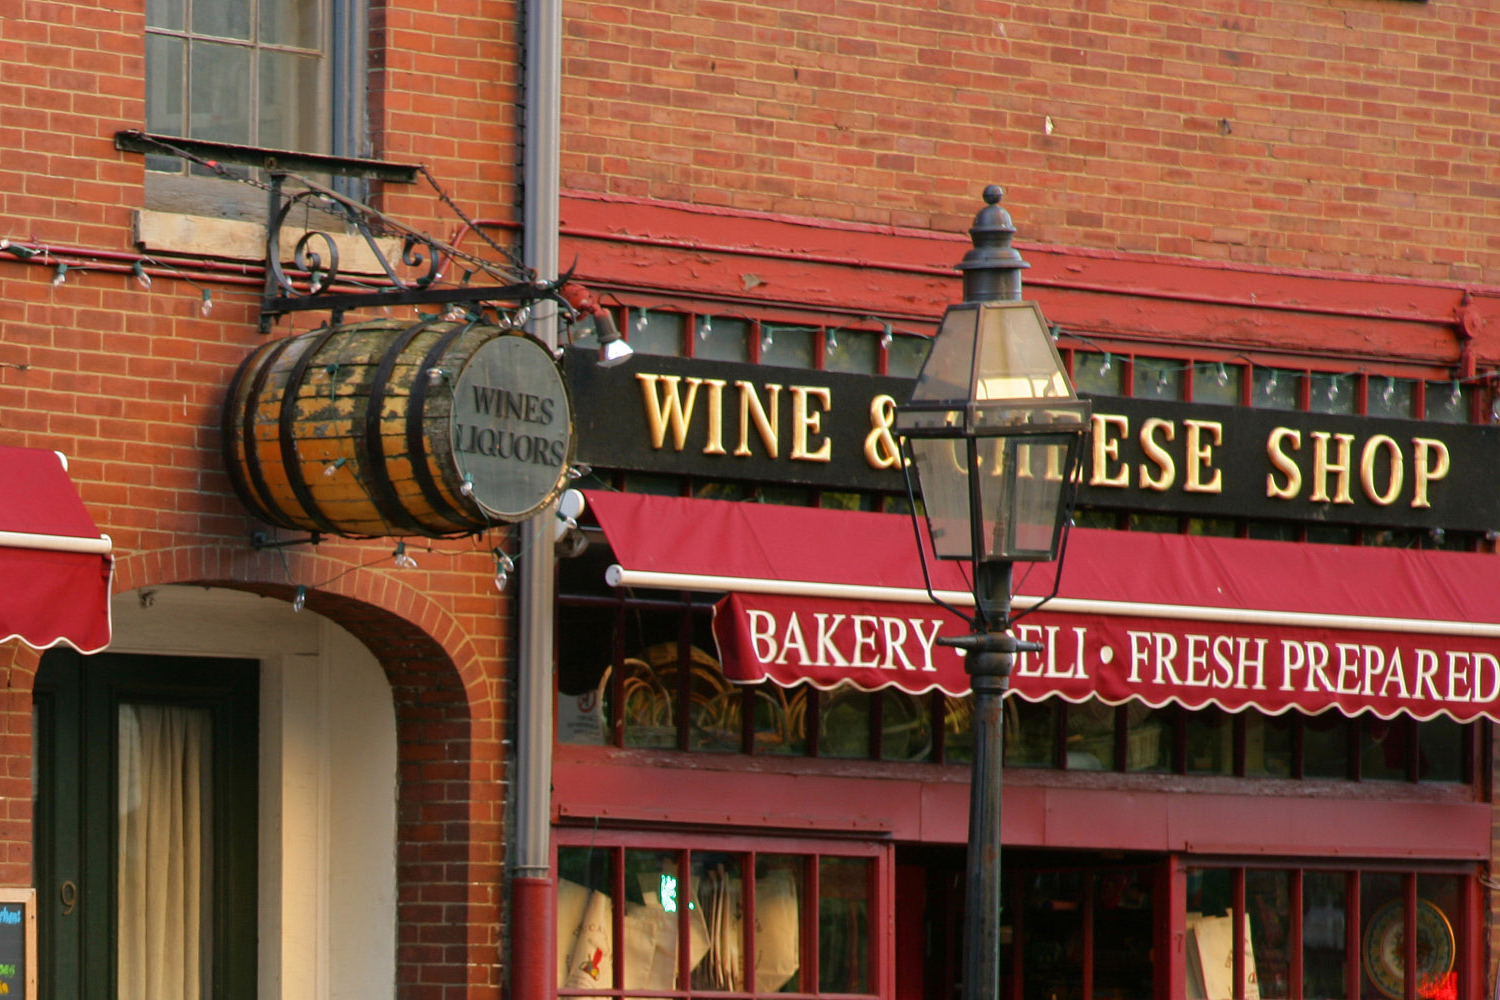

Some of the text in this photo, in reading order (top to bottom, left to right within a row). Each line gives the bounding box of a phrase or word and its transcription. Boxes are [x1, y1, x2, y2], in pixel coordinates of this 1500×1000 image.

[473, 384, 554, 425] WINES
[456, 424, 564, 468] LIQUORS
[635, 372, 832, 463] WINE
[863, 394, 911, 471] &
[1266, 426, 1451, 509] SHOP
[746, 608, 1500, 705] BAKERY ELI FRESH PREPARED
[61, 880, 77, 915] 9
